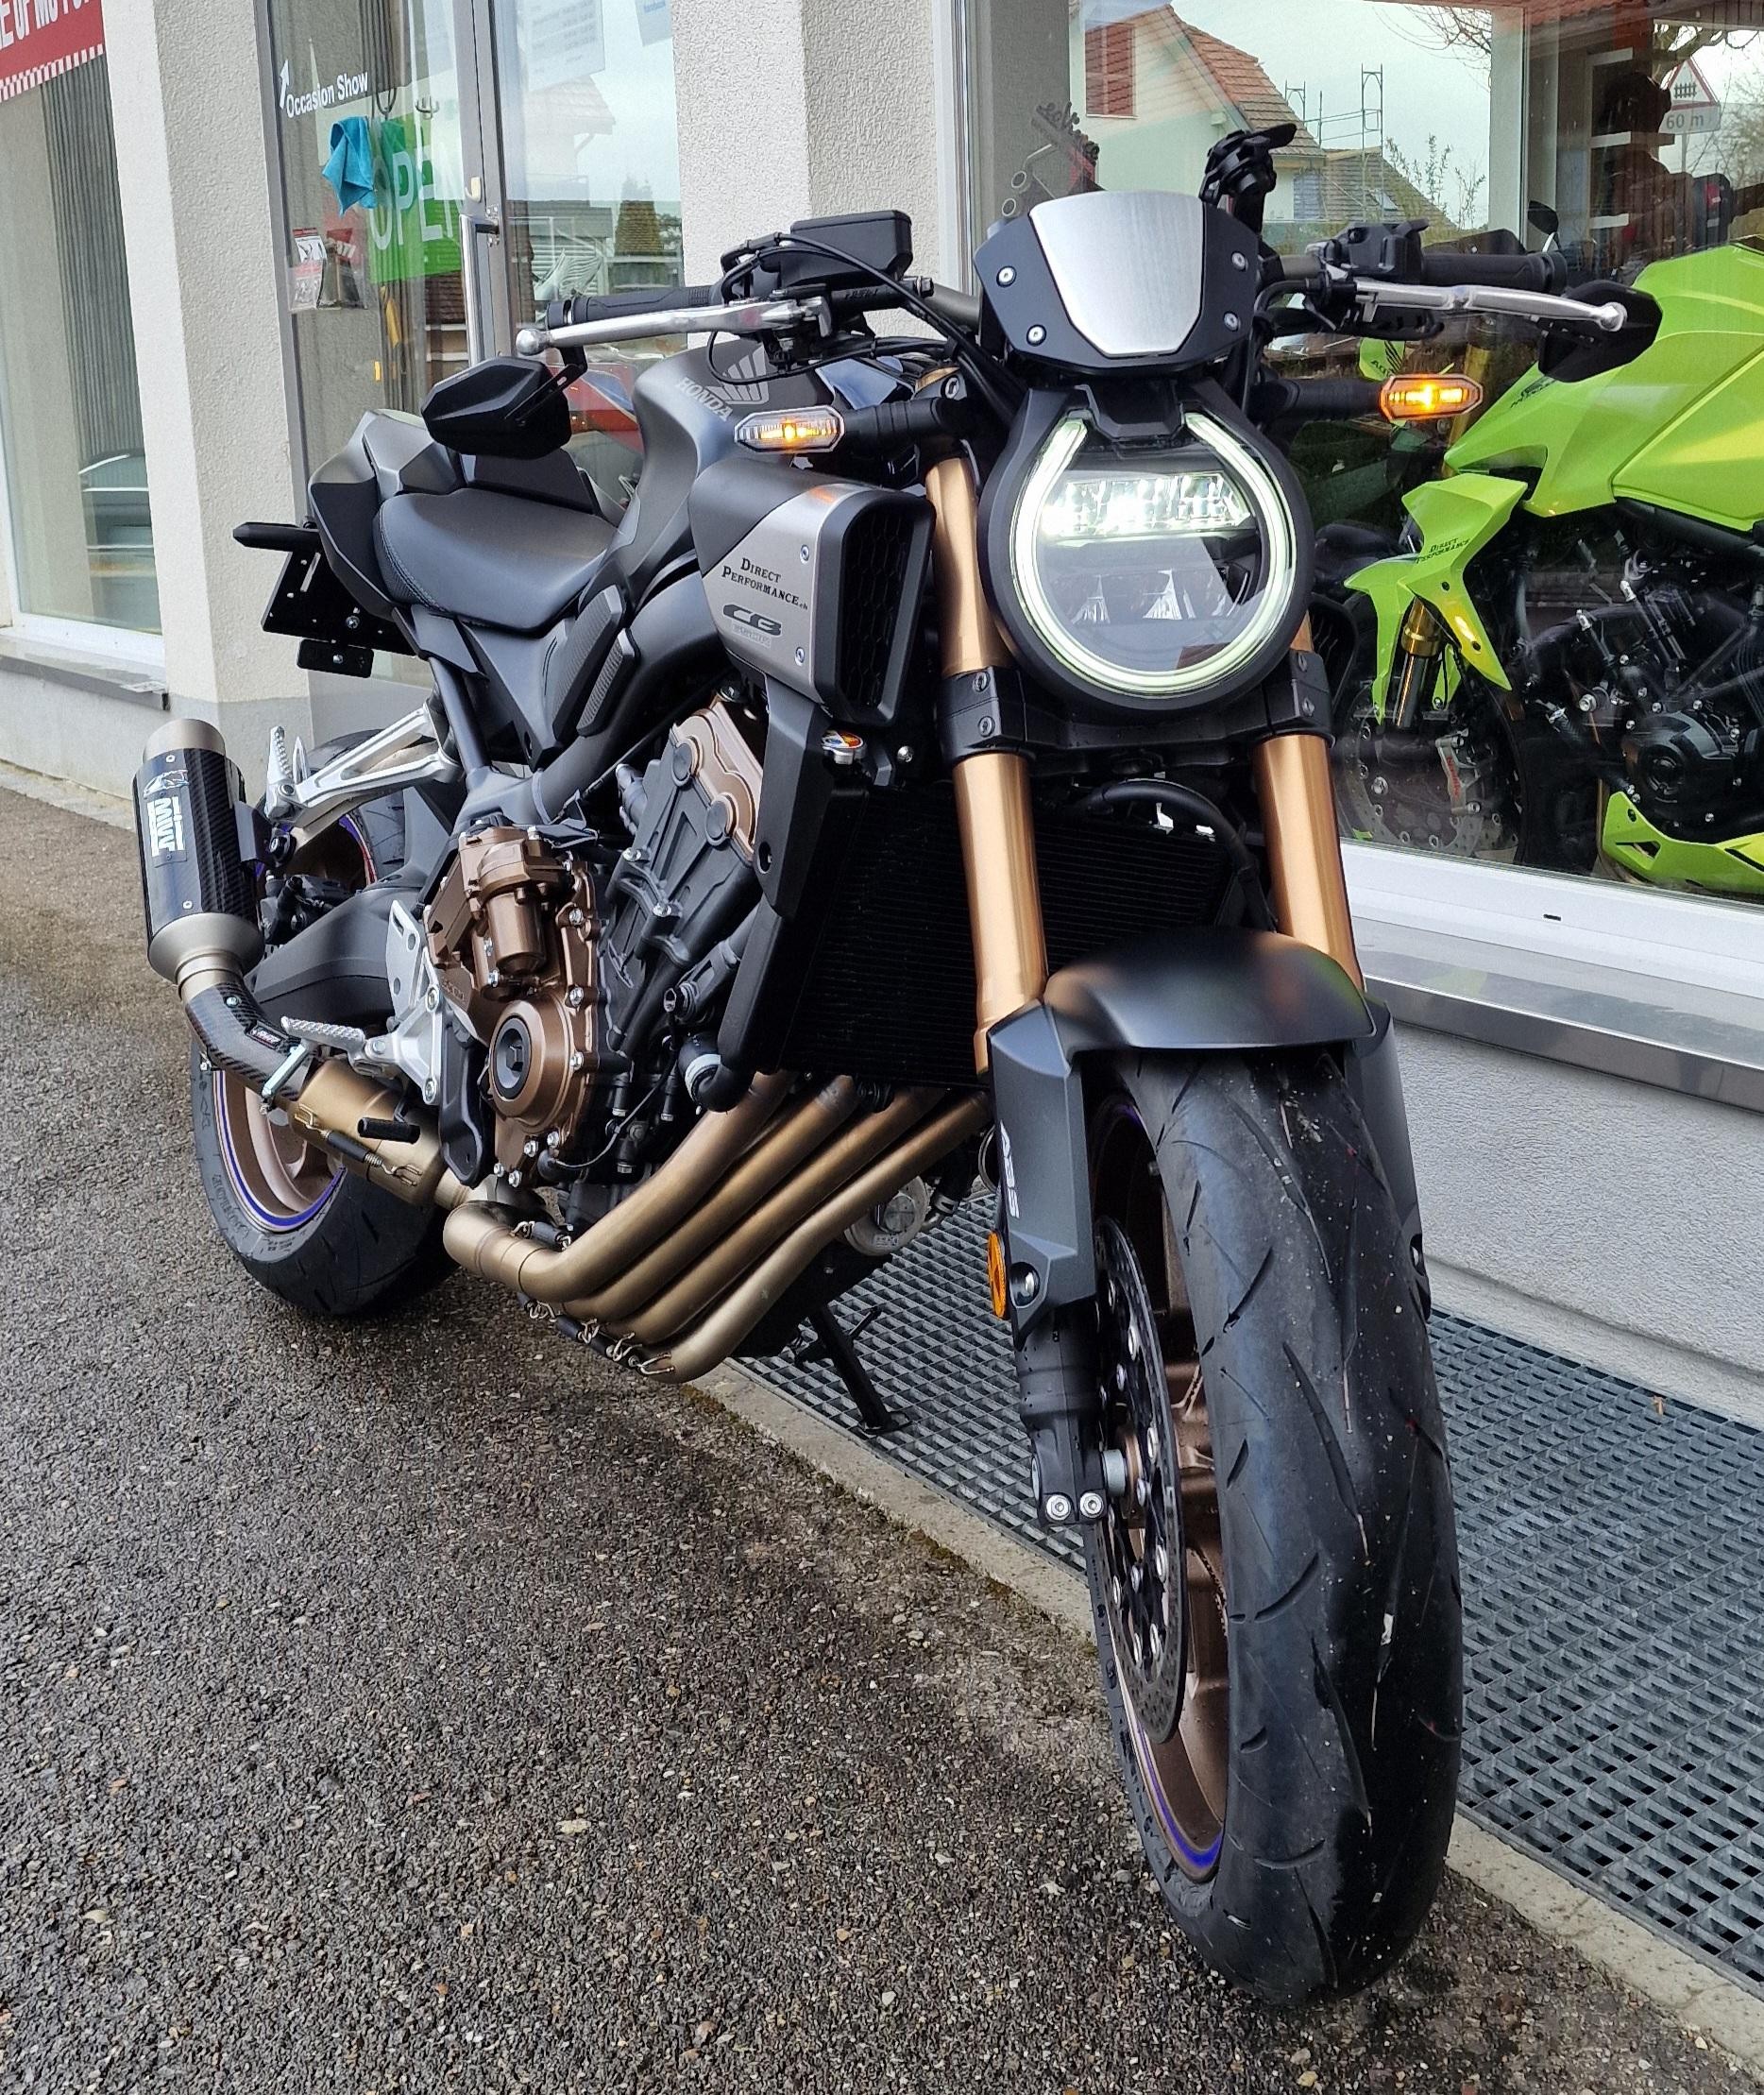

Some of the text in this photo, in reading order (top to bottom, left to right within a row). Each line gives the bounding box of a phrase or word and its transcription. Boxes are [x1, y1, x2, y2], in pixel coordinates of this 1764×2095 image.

[286, 71, 368, 118] Occasion Show
[1666, 113, 1704, 130] 60 m
[675, 377, 734, 422] HONDA
[723, 604, 782, 637] CB
